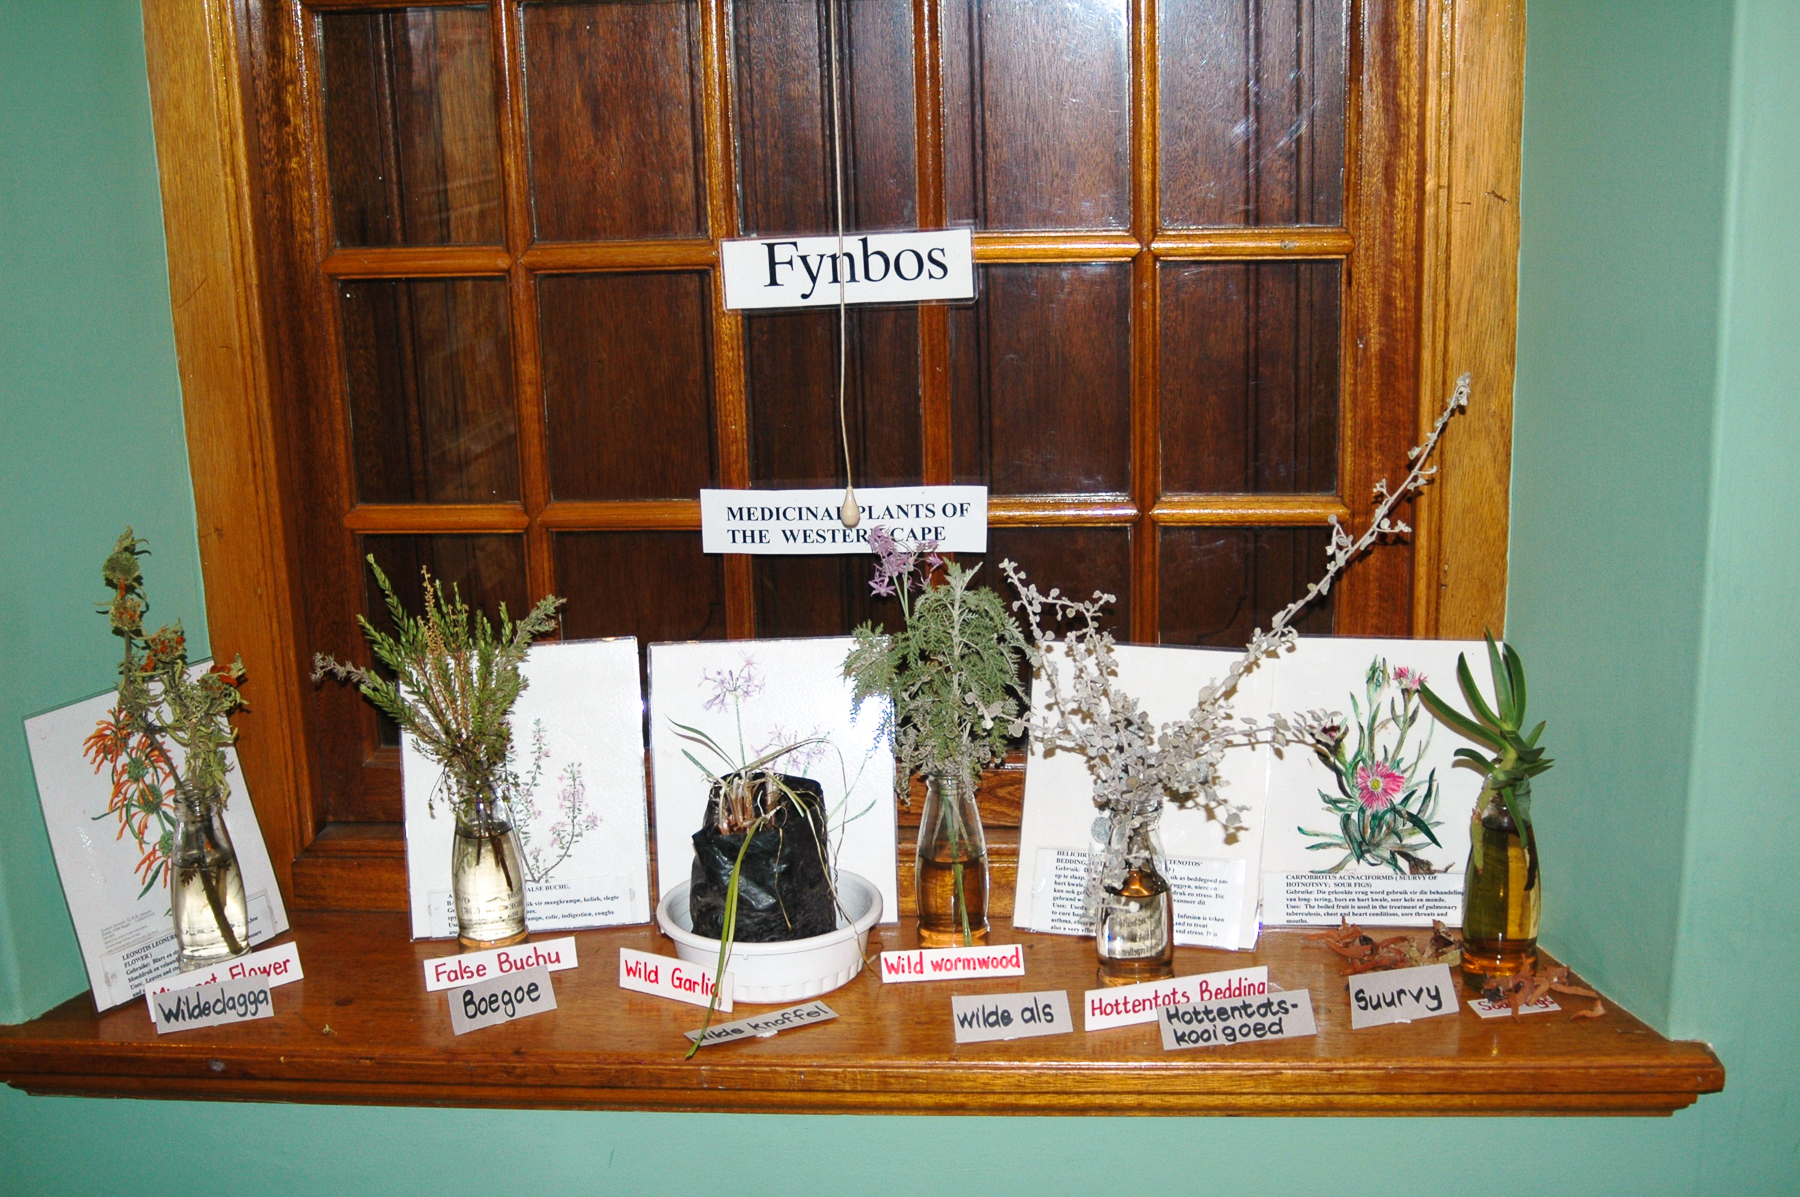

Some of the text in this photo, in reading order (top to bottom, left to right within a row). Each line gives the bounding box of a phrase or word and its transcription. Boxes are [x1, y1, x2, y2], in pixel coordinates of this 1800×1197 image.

[761, 236, 949, 300] Fynbos
[941, 502, 971, 518] OF
[727, 528, 771, 545] THE
[890, 525, 946, 543] CAPE
[121, 933, 178, 961] LEONOTIS LEONUR
[124, 954, 149, 969] FLOWER
[883, 946, 1021, 976] Wild wormwood
[228, 958, 291, 980] Flower
[434, 946, 562, 983] False Buchu
[624, 959, 719, 999] Wild Garlic
[462, 981, 541, 1019] Boegoe
[956, 996, 1055, 1030] wilde als
[1091, 987, 1191, 1018] Hottentots
